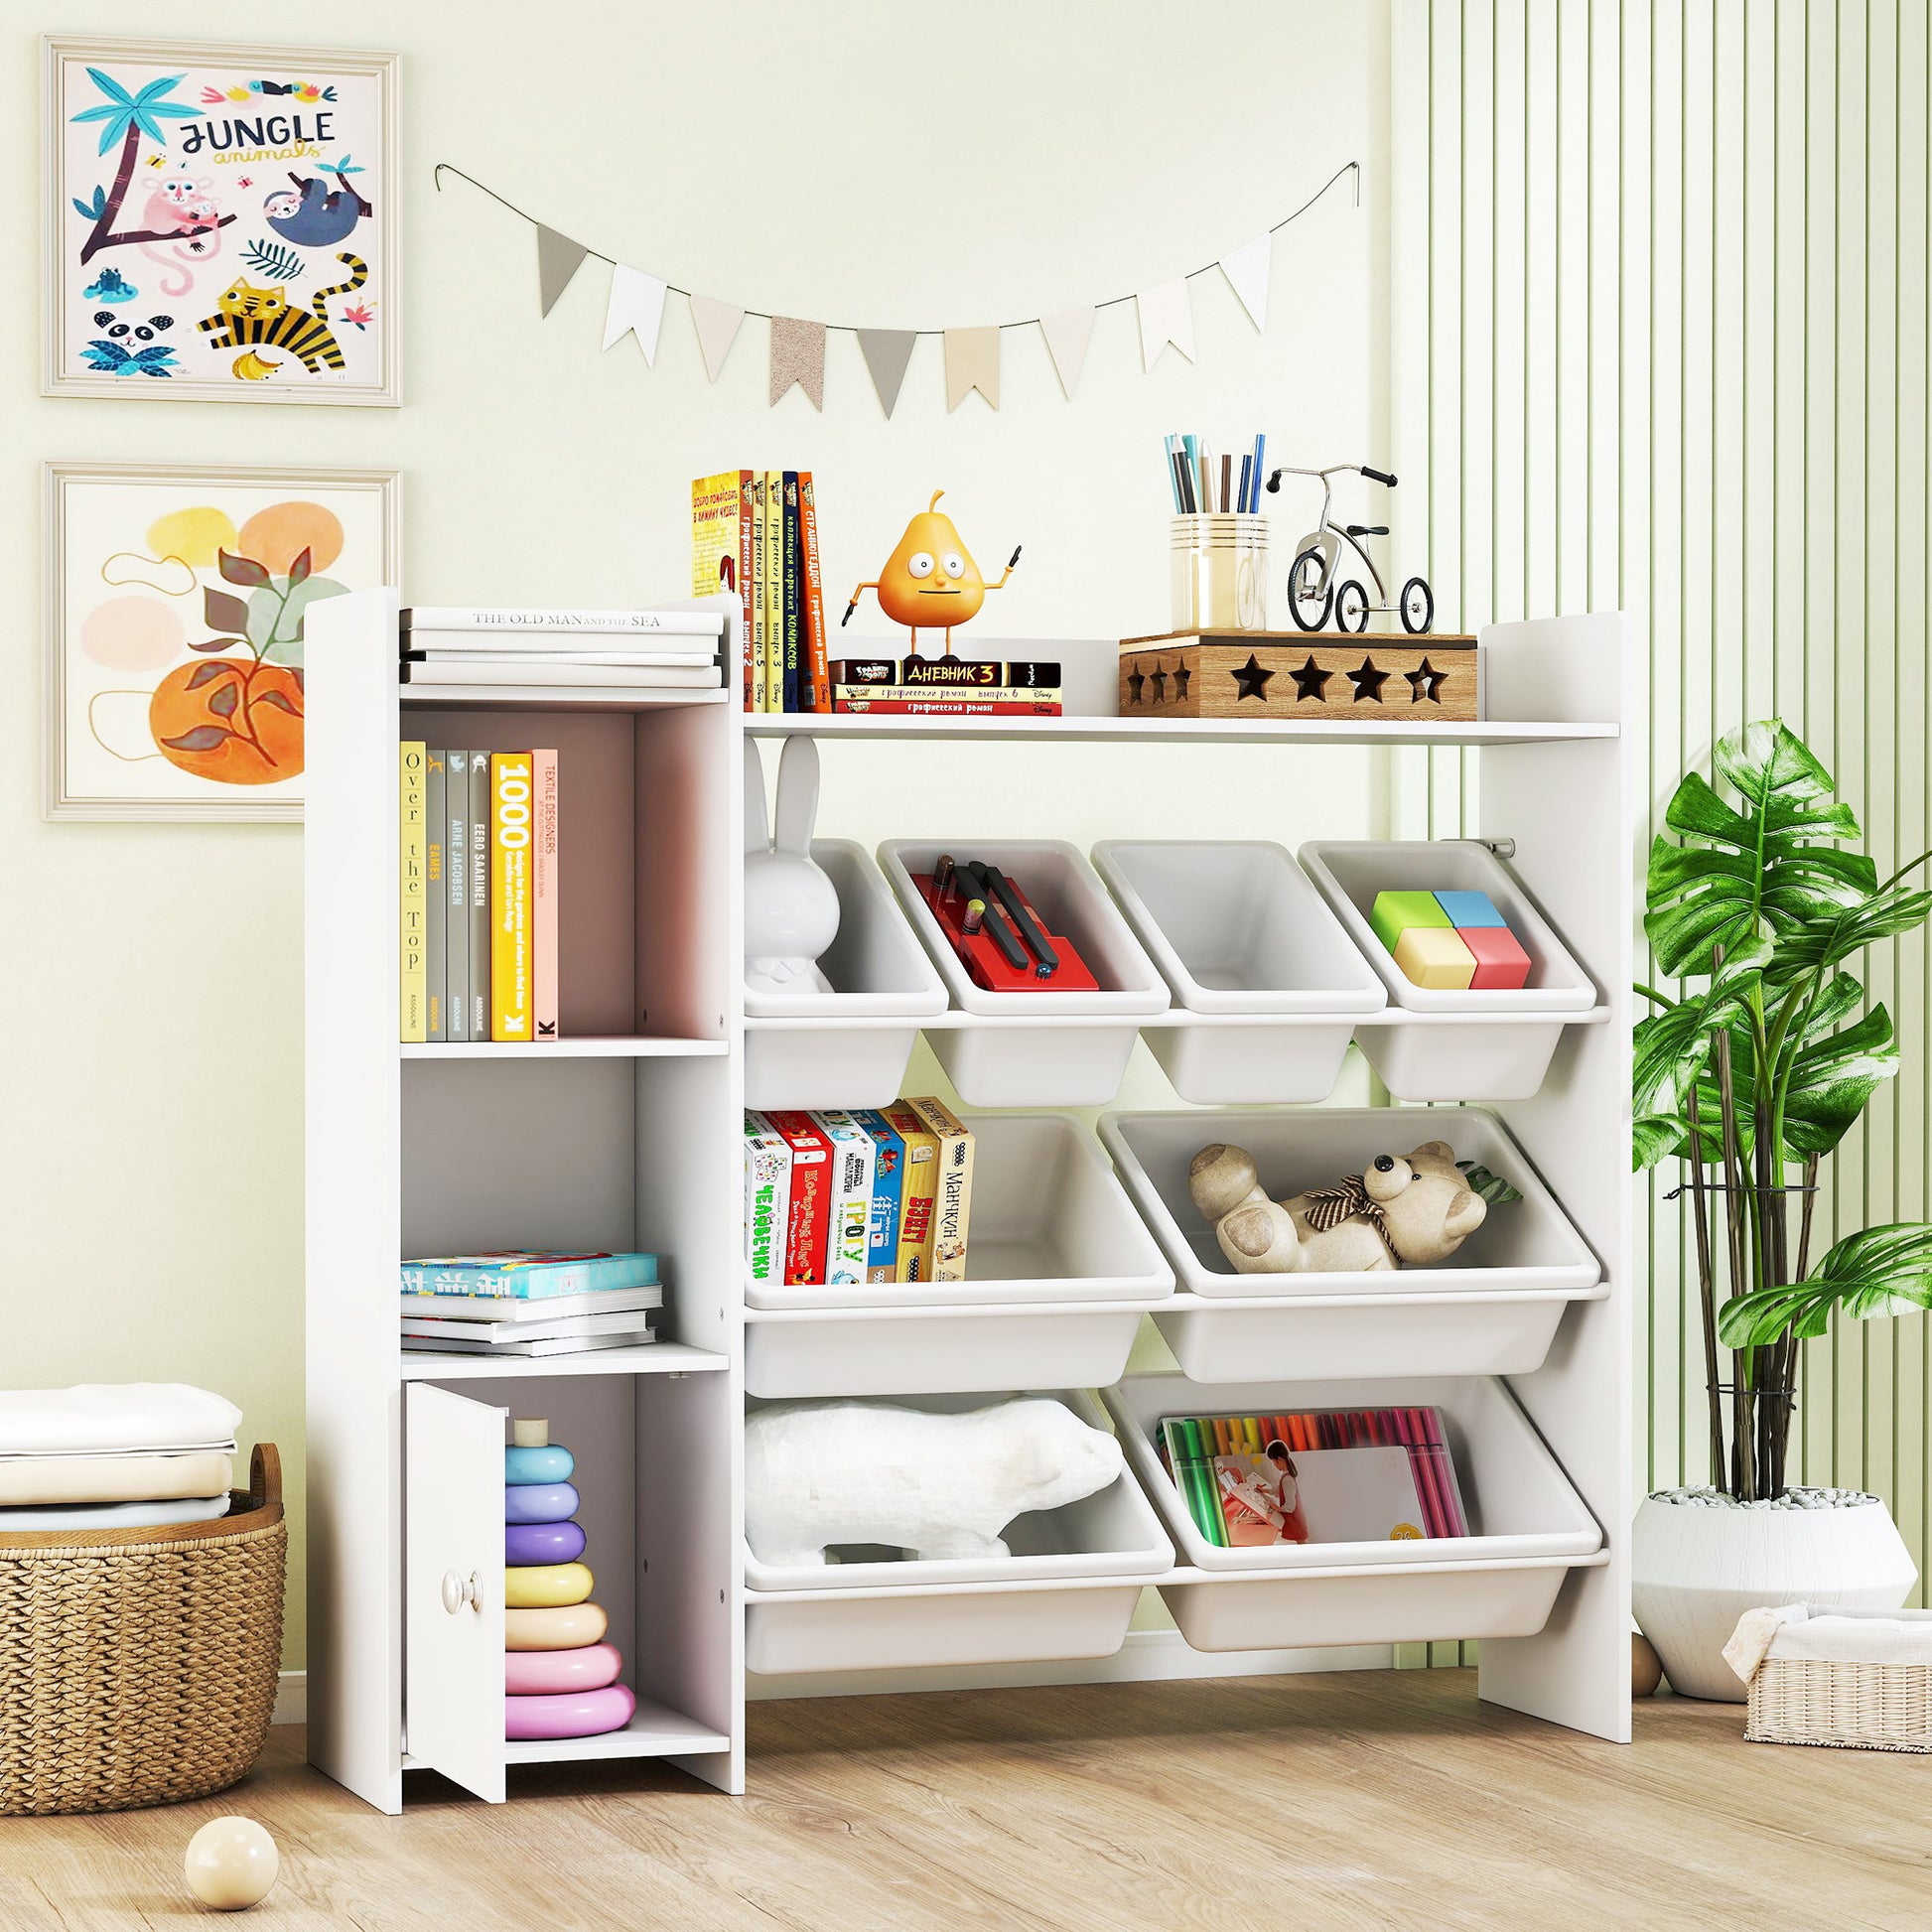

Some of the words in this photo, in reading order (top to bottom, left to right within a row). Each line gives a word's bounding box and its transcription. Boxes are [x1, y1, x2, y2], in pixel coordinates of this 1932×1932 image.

[180, 112, 335, 155] JUNGLE
[213, 138, 326, 165] animals
[786, 515, 795, 565] коллекция
[805, 510, 821, 588] СТРАННОГЕДДОН
[784, 568, 795, 611] коротких
[473, 613, 506, 624] THE
[509, 614, 544, 625] OLD
[546, 614, 584, 625] MAN
[584, 617, 607, 625] AND
[607, 618, 627, 626] THE
[630, 616, 661, 627] SEA
[811, 595, 824, 647] графический
[787, 614, 797, 670] КОМИКСОВ
[813, 650, 826, 676] роман
[907, 664, 976, 682] ДНЕВНИК
[980, 665, 994, 683] 3
[1012, 688, 1019, 698] 6
[406, 752, 420, 821] Over
[545, 765, 555, 801] TEXTILE
[499, 763, 529, 849] 1000
[451, 819, 463, 851] ARNE
[474, 823, 485, 850] EERO
[545, 803, 555, 855] DESIGNERS
[408, 843, 419, 894] the
[429, 844, 441, 881] EAMES
[451, 852, 463, 906] JACOBSEN
[474, 851, 485, 907] SAARINEN
[514, 850, 525, 877] designs
[516, 878, 525, 889] for
[504, 885, 514, 897] and
[516, 890, 525, 900] the
[406, 911, 420, 970] Top
[538, 1021, 555, 1035] K
[900, 1196, 933, 1244] БЭНГ!
[940, 1173, 963, 1239] Манчкин
[753, 1184, 775, 1280] ЧЕЛОВЕЧКИ
[797, 1239, 813, 1268] Лис
[843, 1201, 867, 1263] ГРОГУ
